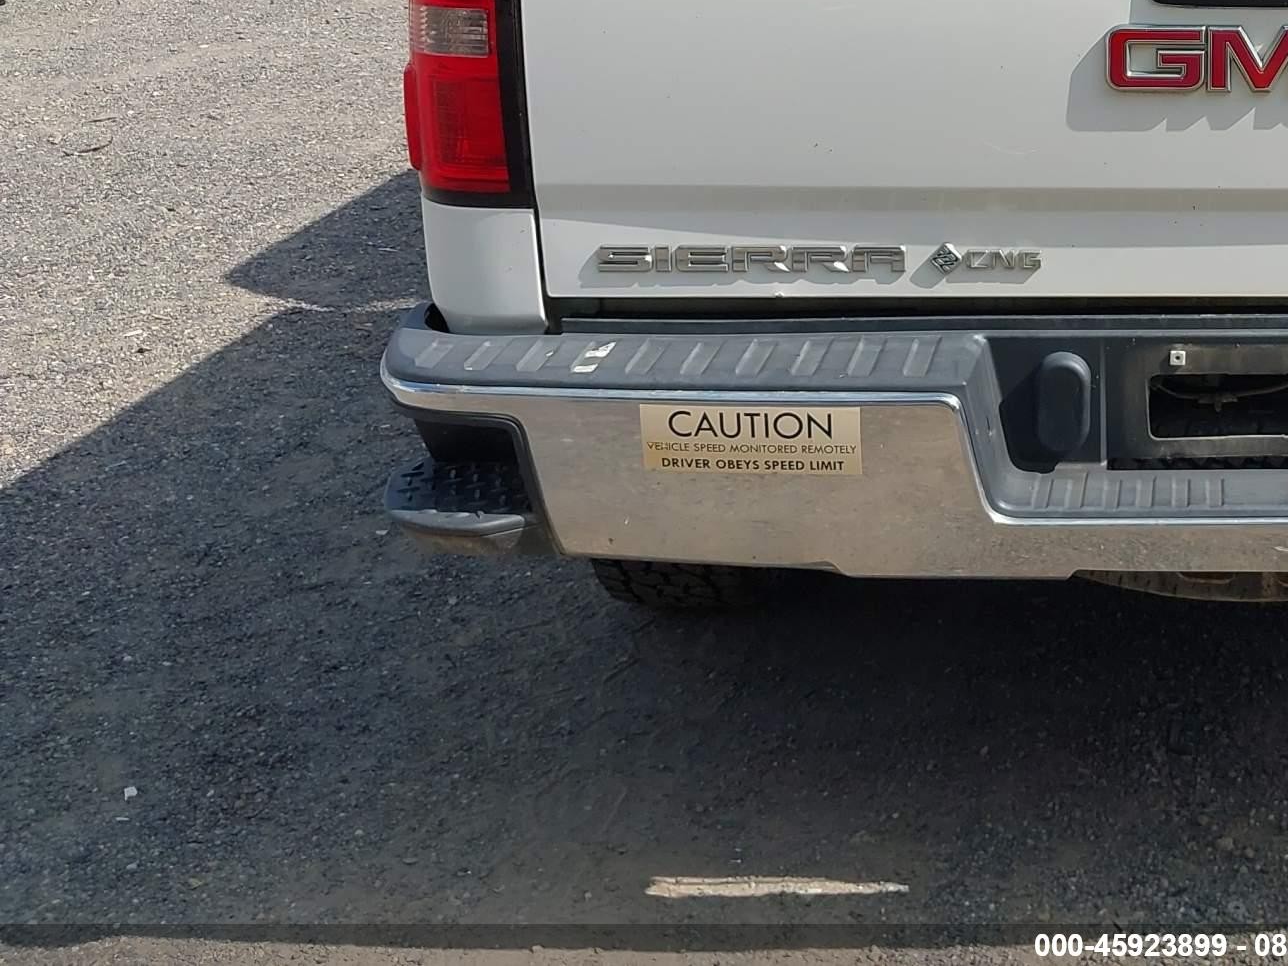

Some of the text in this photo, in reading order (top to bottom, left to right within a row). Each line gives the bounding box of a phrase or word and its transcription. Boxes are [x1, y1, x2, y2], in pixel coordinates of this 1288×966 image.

[598, 245, 1042, 274] SIERRA CNG
[668, 410, 833, 440] CAUTION
[647, 442, 857, 455] VEHICLE SPEED MONITORED REMOTELY
[661, 457, 845, 471] DRIVER OBEYS SPEED LIMIT
